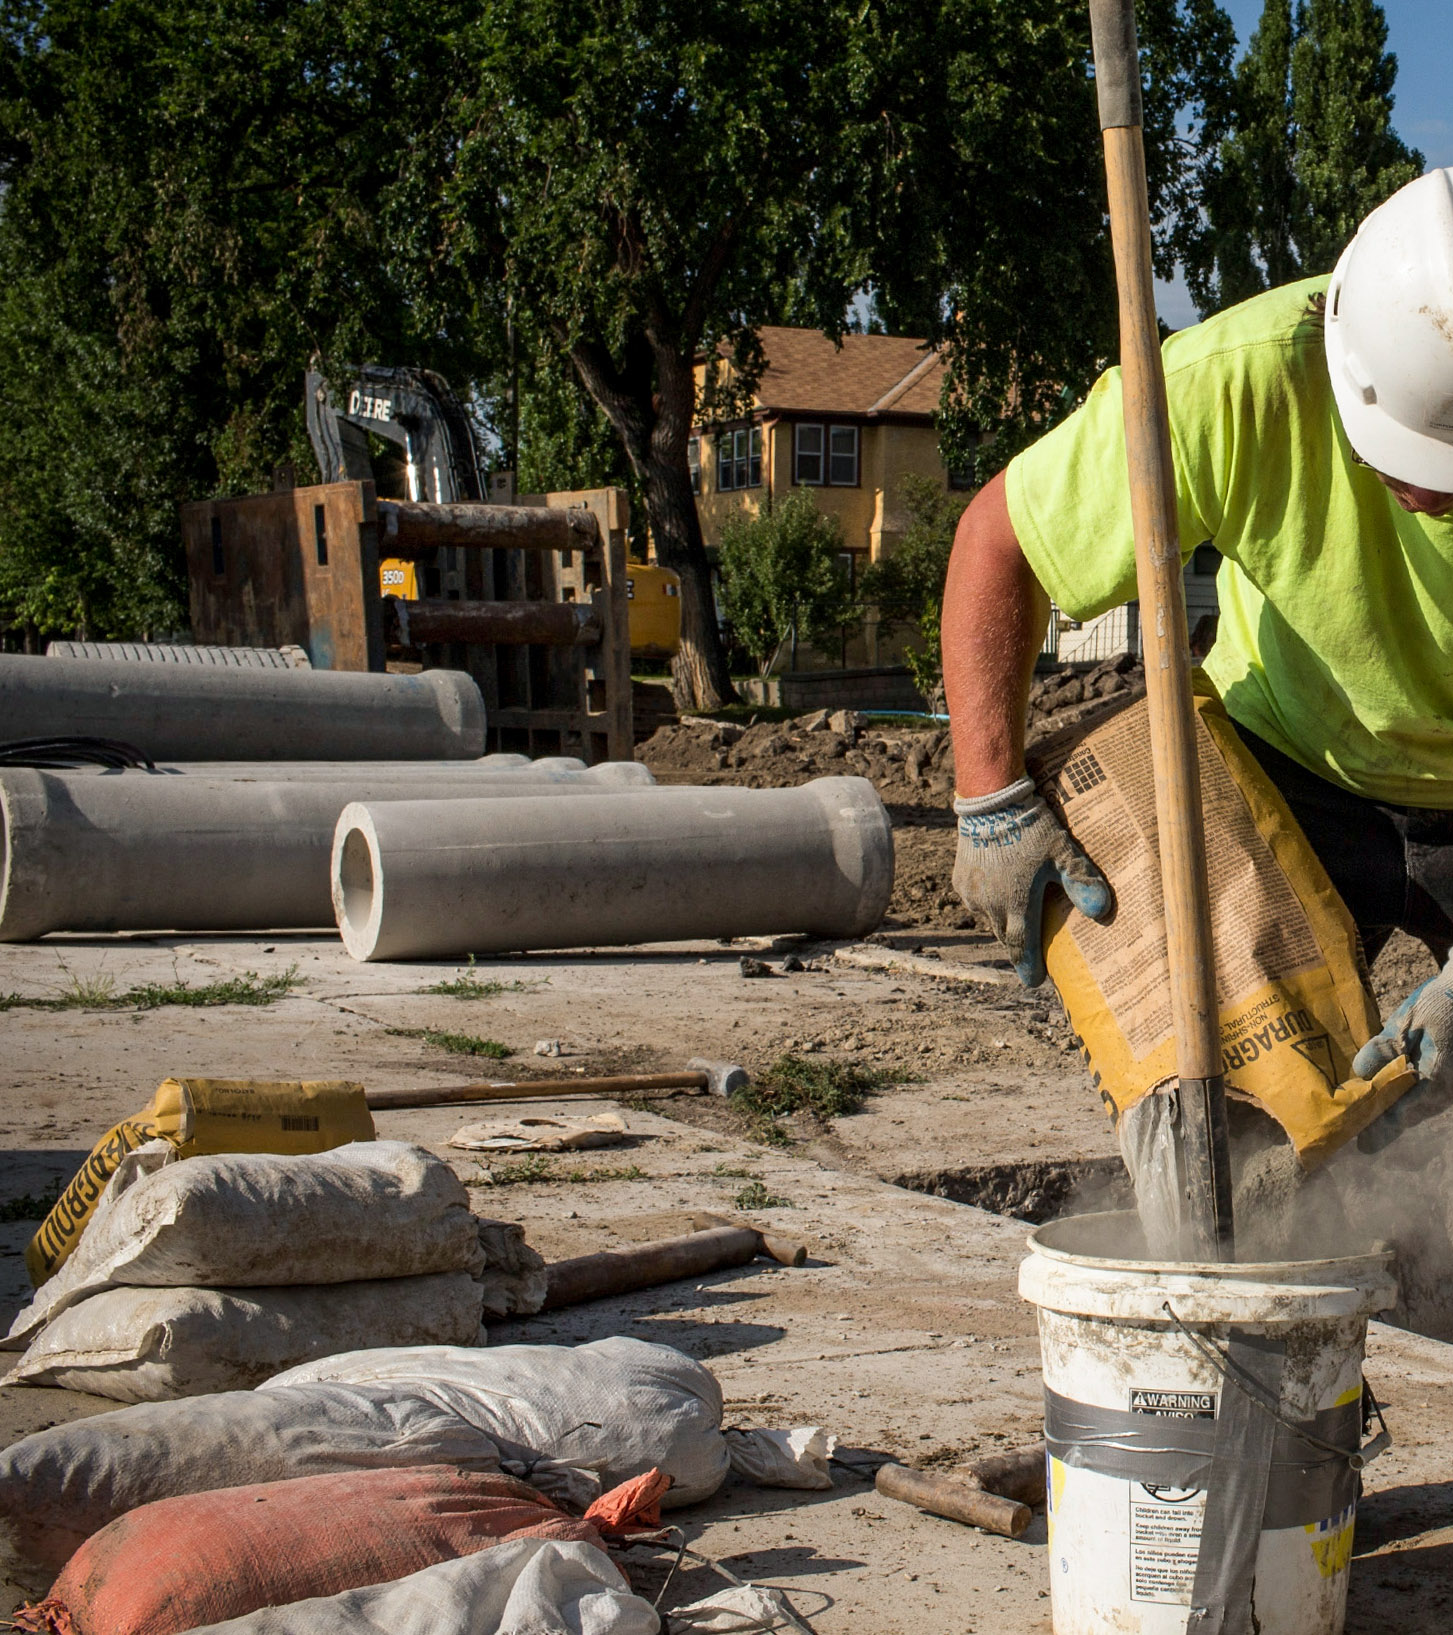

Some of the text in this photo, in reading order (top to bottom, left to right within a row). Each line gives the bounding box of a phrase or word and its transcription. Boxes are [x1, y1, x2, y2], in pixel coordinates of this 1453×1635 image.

[1220, 1012, 1268, 1045] NON-SHRIN
[1224, 994, 1280, 1030] STRUCTURAL
[1147, 1393, 1210, 1408] WARNING
